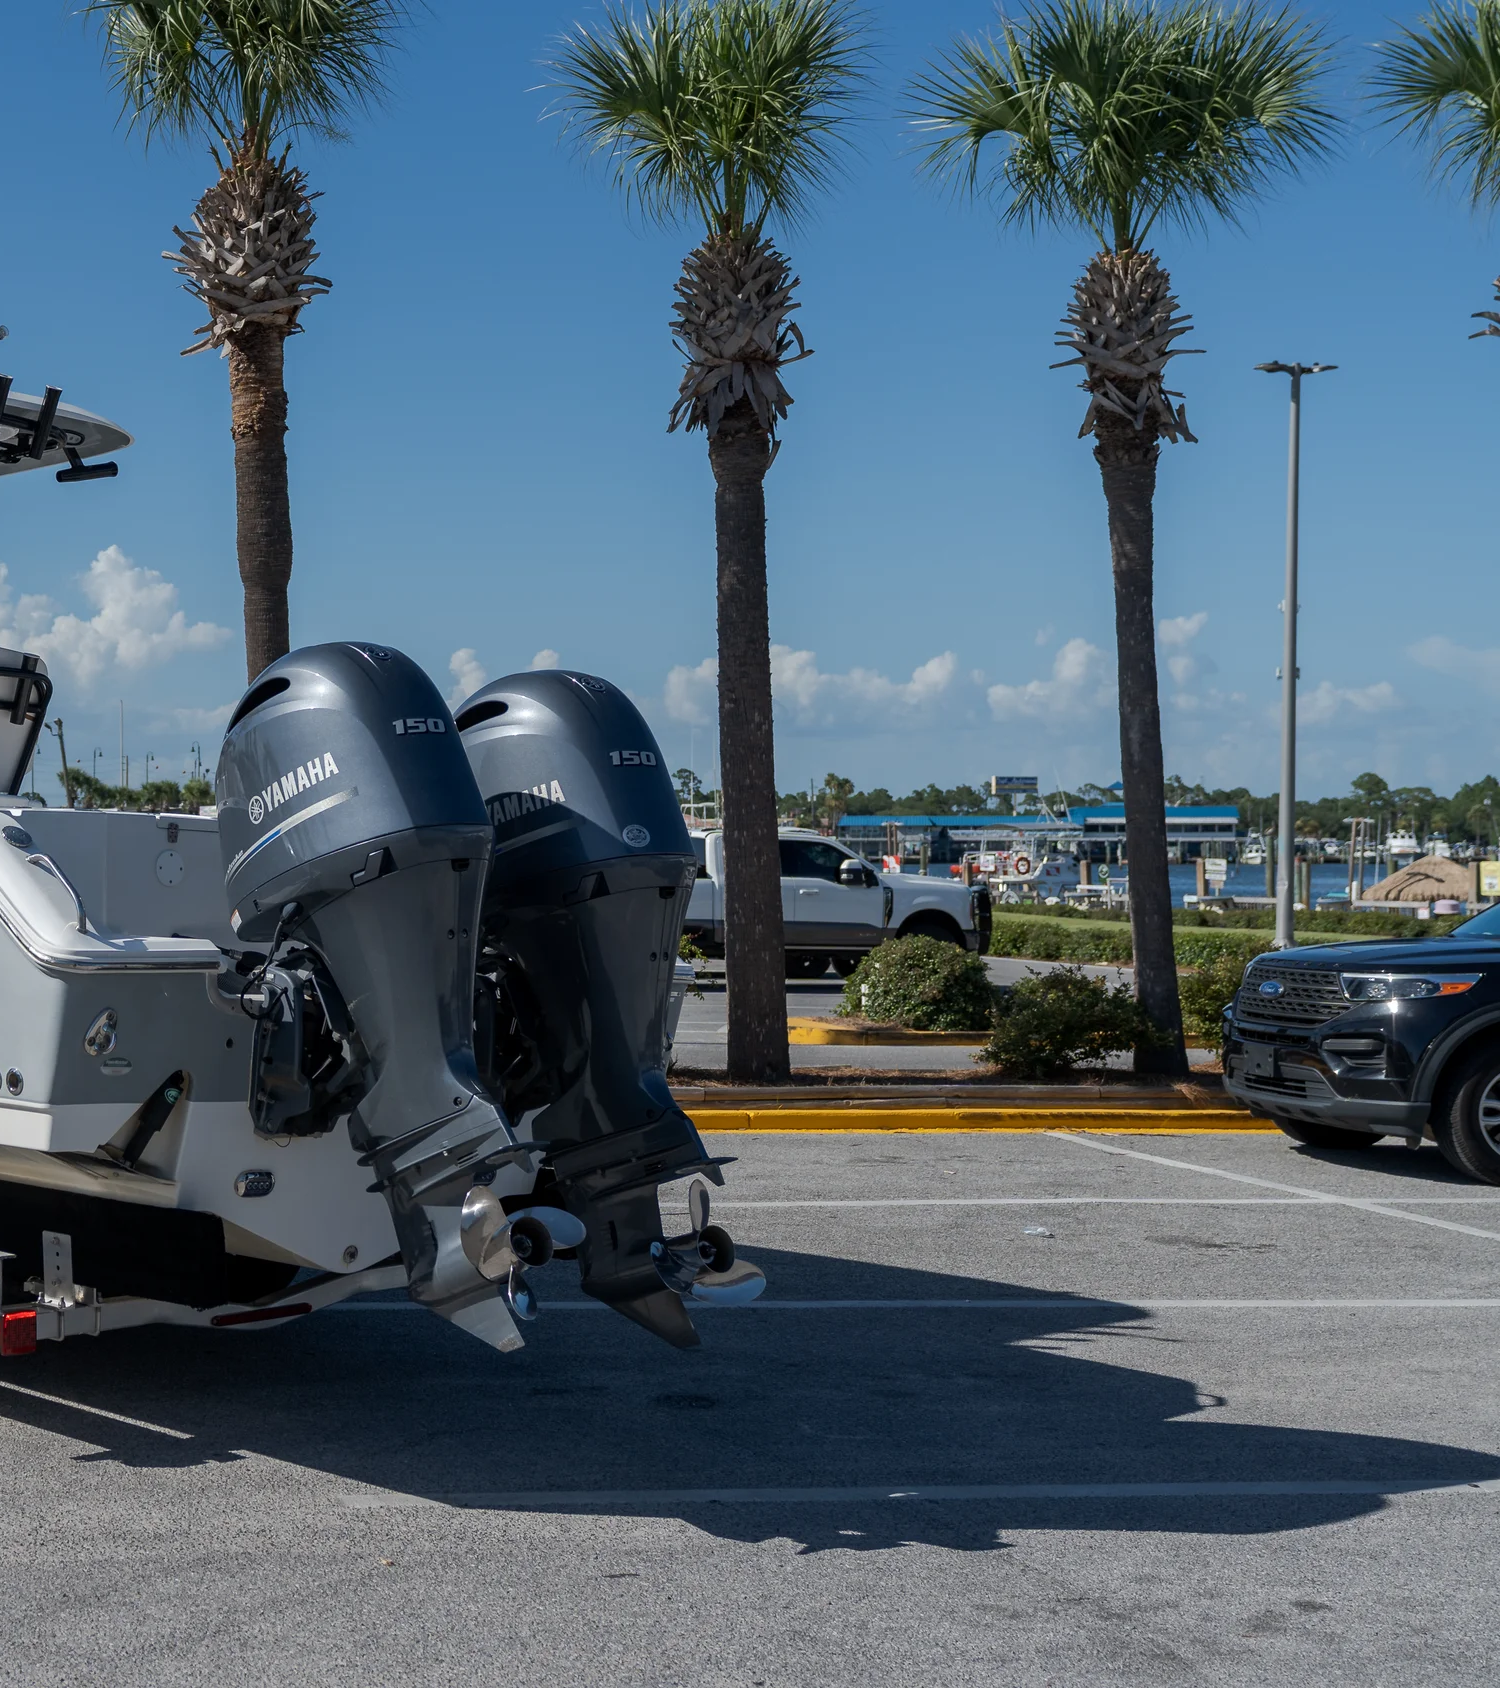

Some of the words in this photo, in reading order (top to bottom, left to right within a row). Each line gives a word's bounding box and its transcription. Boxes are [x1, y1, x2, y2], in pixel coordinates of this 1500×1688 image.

[392, 717, 446, 735] 150
[609, 750, 657, 766] 150
[261, 751, 340, 813] YAMAHA
